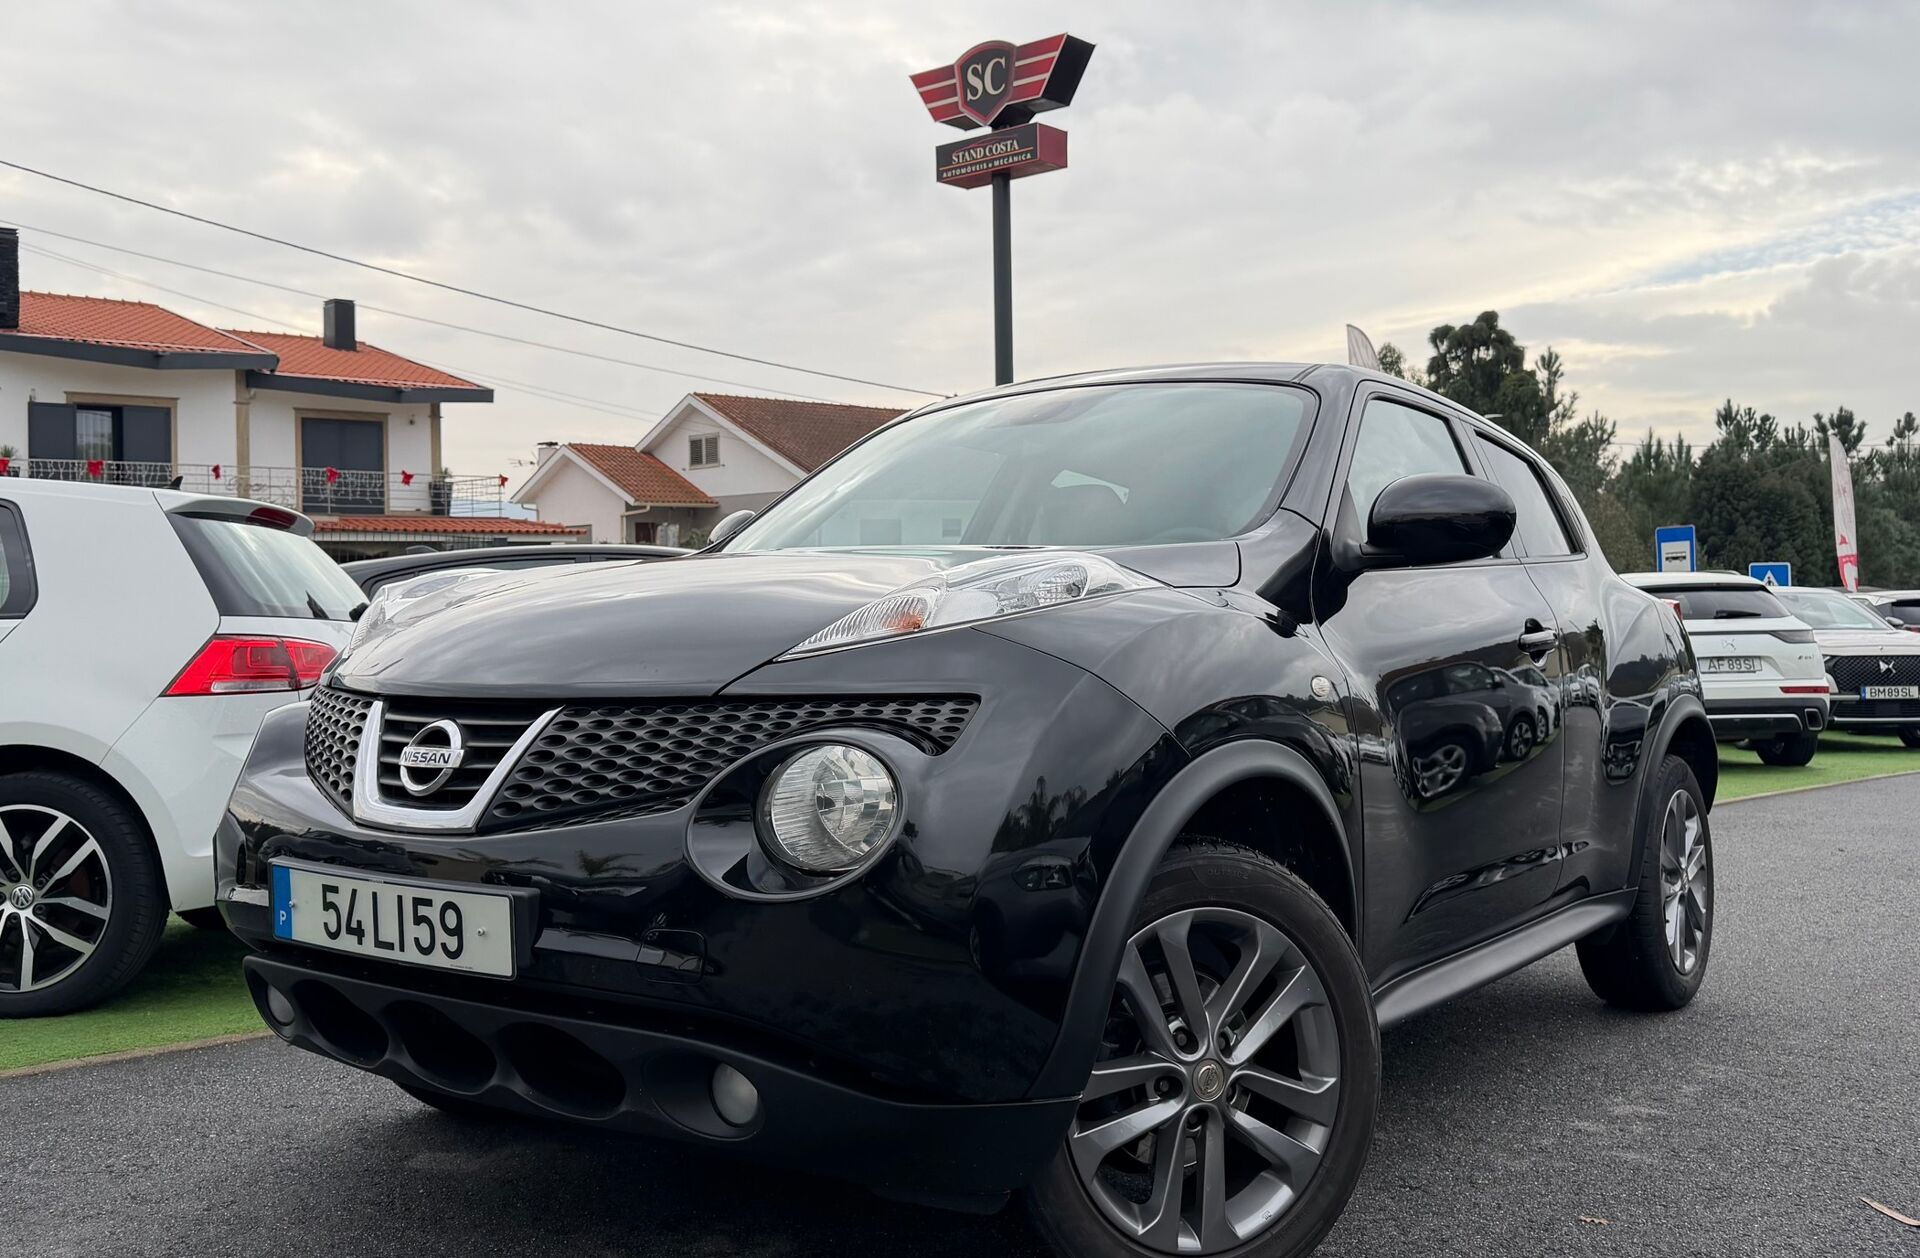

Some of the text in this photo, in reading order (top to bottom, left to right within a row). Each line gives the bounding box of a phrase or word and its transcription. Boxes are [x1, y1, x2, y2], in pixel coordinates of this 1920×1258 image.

[966, 56, 1006, 101] SC
[952, 139, 1019, 165] STAND COSTA
[401, 751, 451, 764] NISSAN
[279, 910, 287, 926] P
